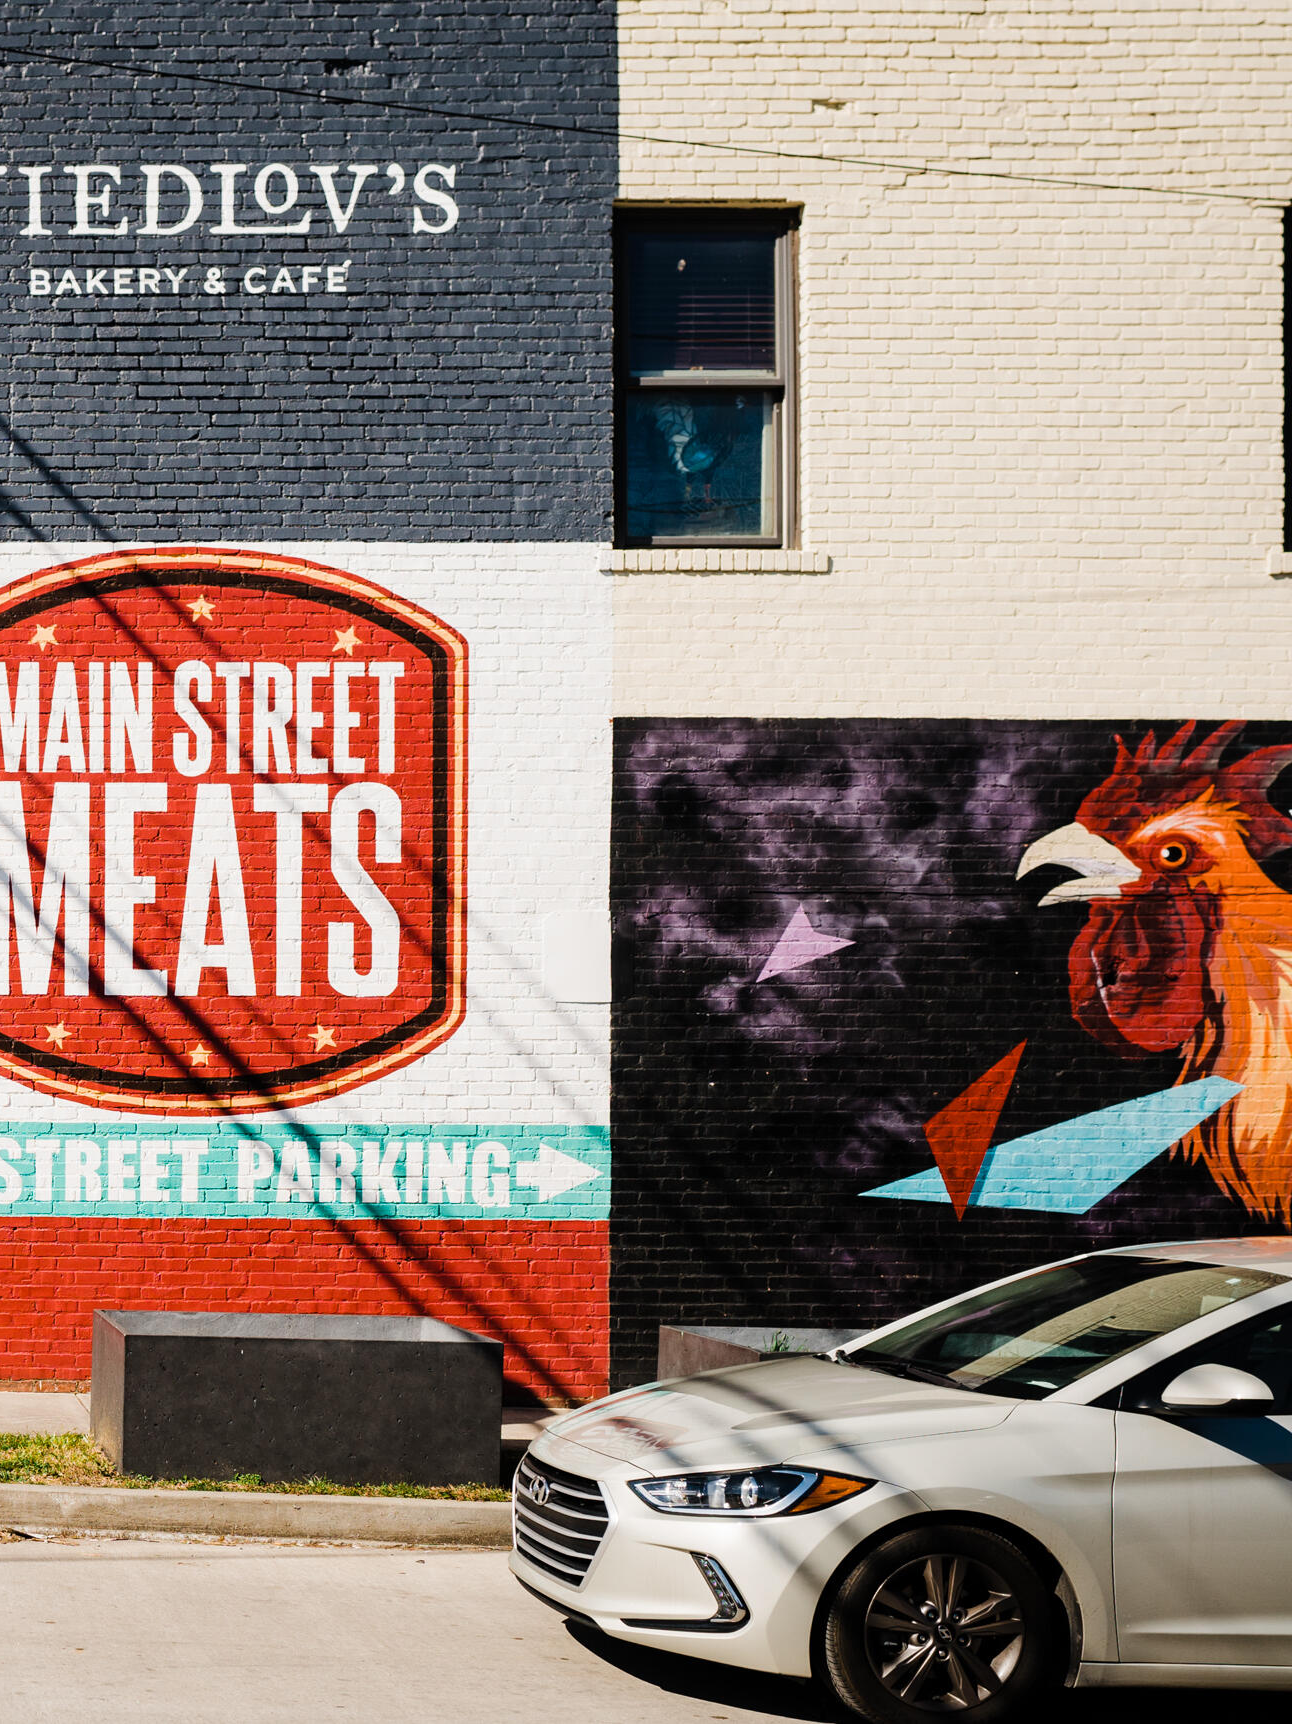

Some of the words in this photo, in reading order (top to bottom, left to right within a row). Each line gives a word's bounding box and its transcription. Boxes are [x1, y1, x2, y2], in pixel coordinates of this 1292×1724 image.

[28, 267, 187, 295] BAKERY
[203, 267, 226, 295] &
[244, 259, 352, 294] CAFÉ
[172, 658, 405, 778] STREET
[237, 1139, 511, 1208] PARKING
